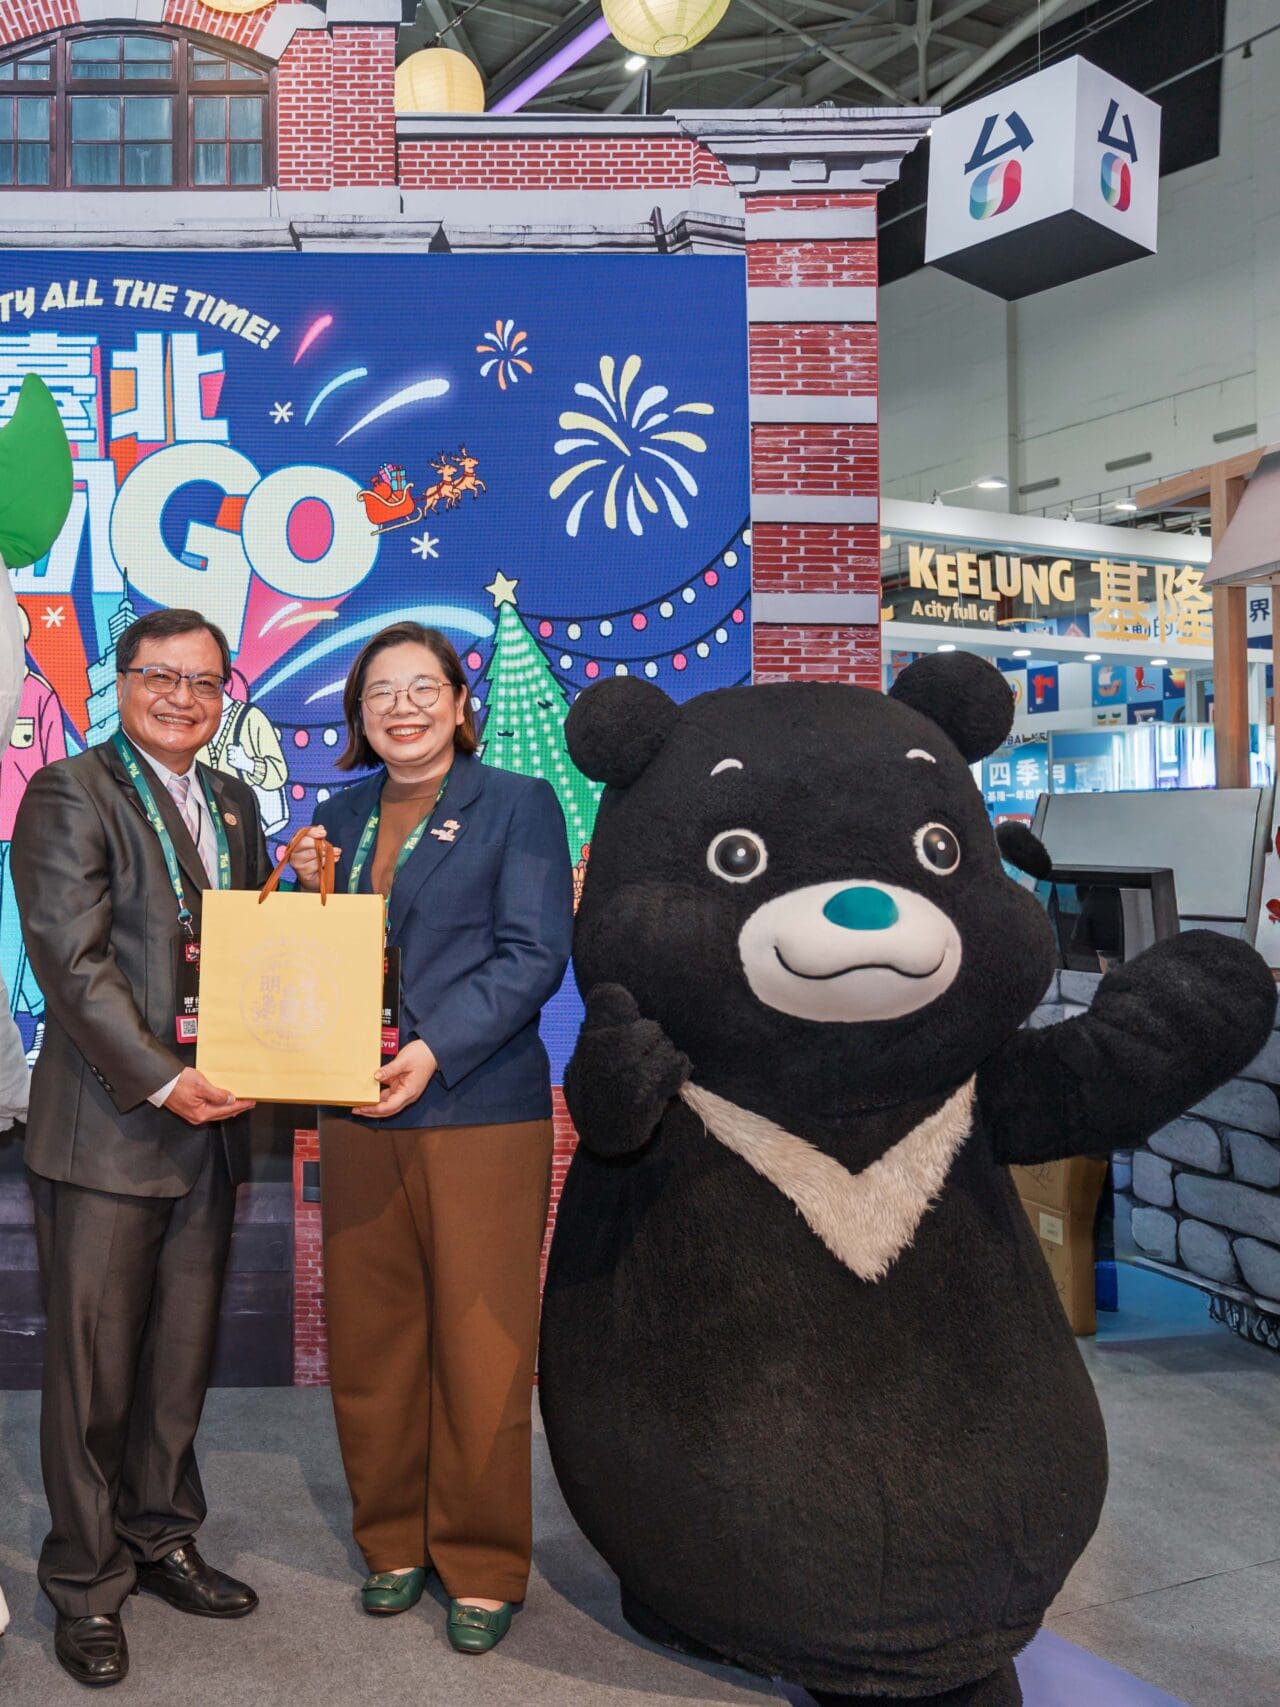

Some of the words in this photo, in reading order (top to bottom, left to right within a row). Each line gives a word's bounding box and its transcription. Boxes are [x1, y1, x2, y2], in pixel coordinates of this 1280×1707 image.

[41, 278, 103, 311] ALL
[113, 278, 178, 312] THE
[183, 289, 281, 350] TIME!
[908, 544, 1075, 606] KEELUNG
[1090, 558, 1213, 646] 基隆
[911, 600, 924, 617] A
[925, 600, 951, 622] city
[952, 602, 979, 621] full
[979, 605, 997, 622] of
